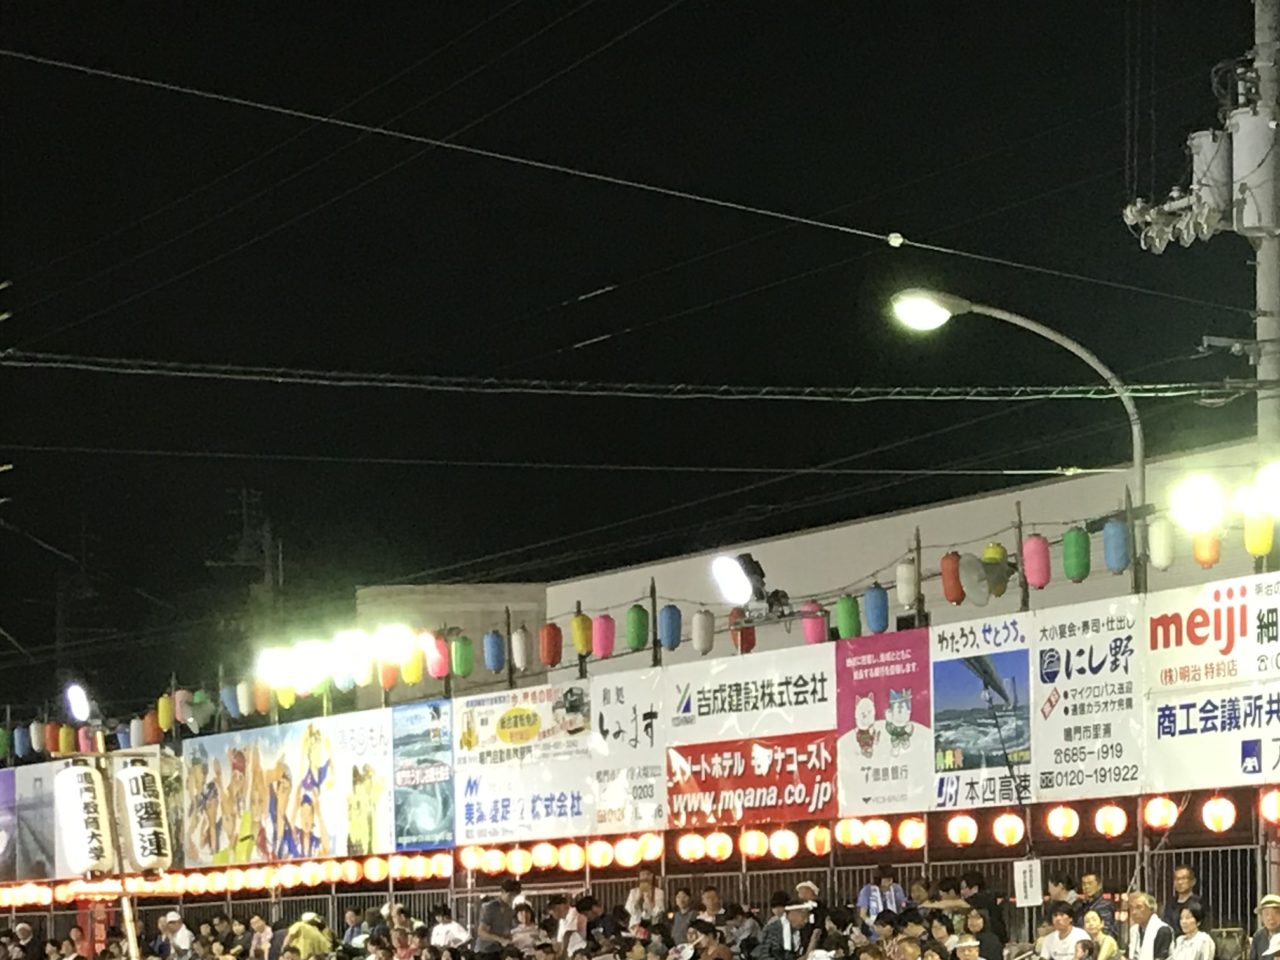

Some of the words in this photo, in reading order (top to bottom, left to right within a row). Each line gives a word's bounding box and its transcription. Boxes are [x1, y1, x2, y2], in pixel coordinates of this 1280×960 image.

[1149, 584, 1248, 656] meiji
[696, 671, 829, 718] 吉成建設株式会社
[1055, 764, 1139, 787] 0120-191922
